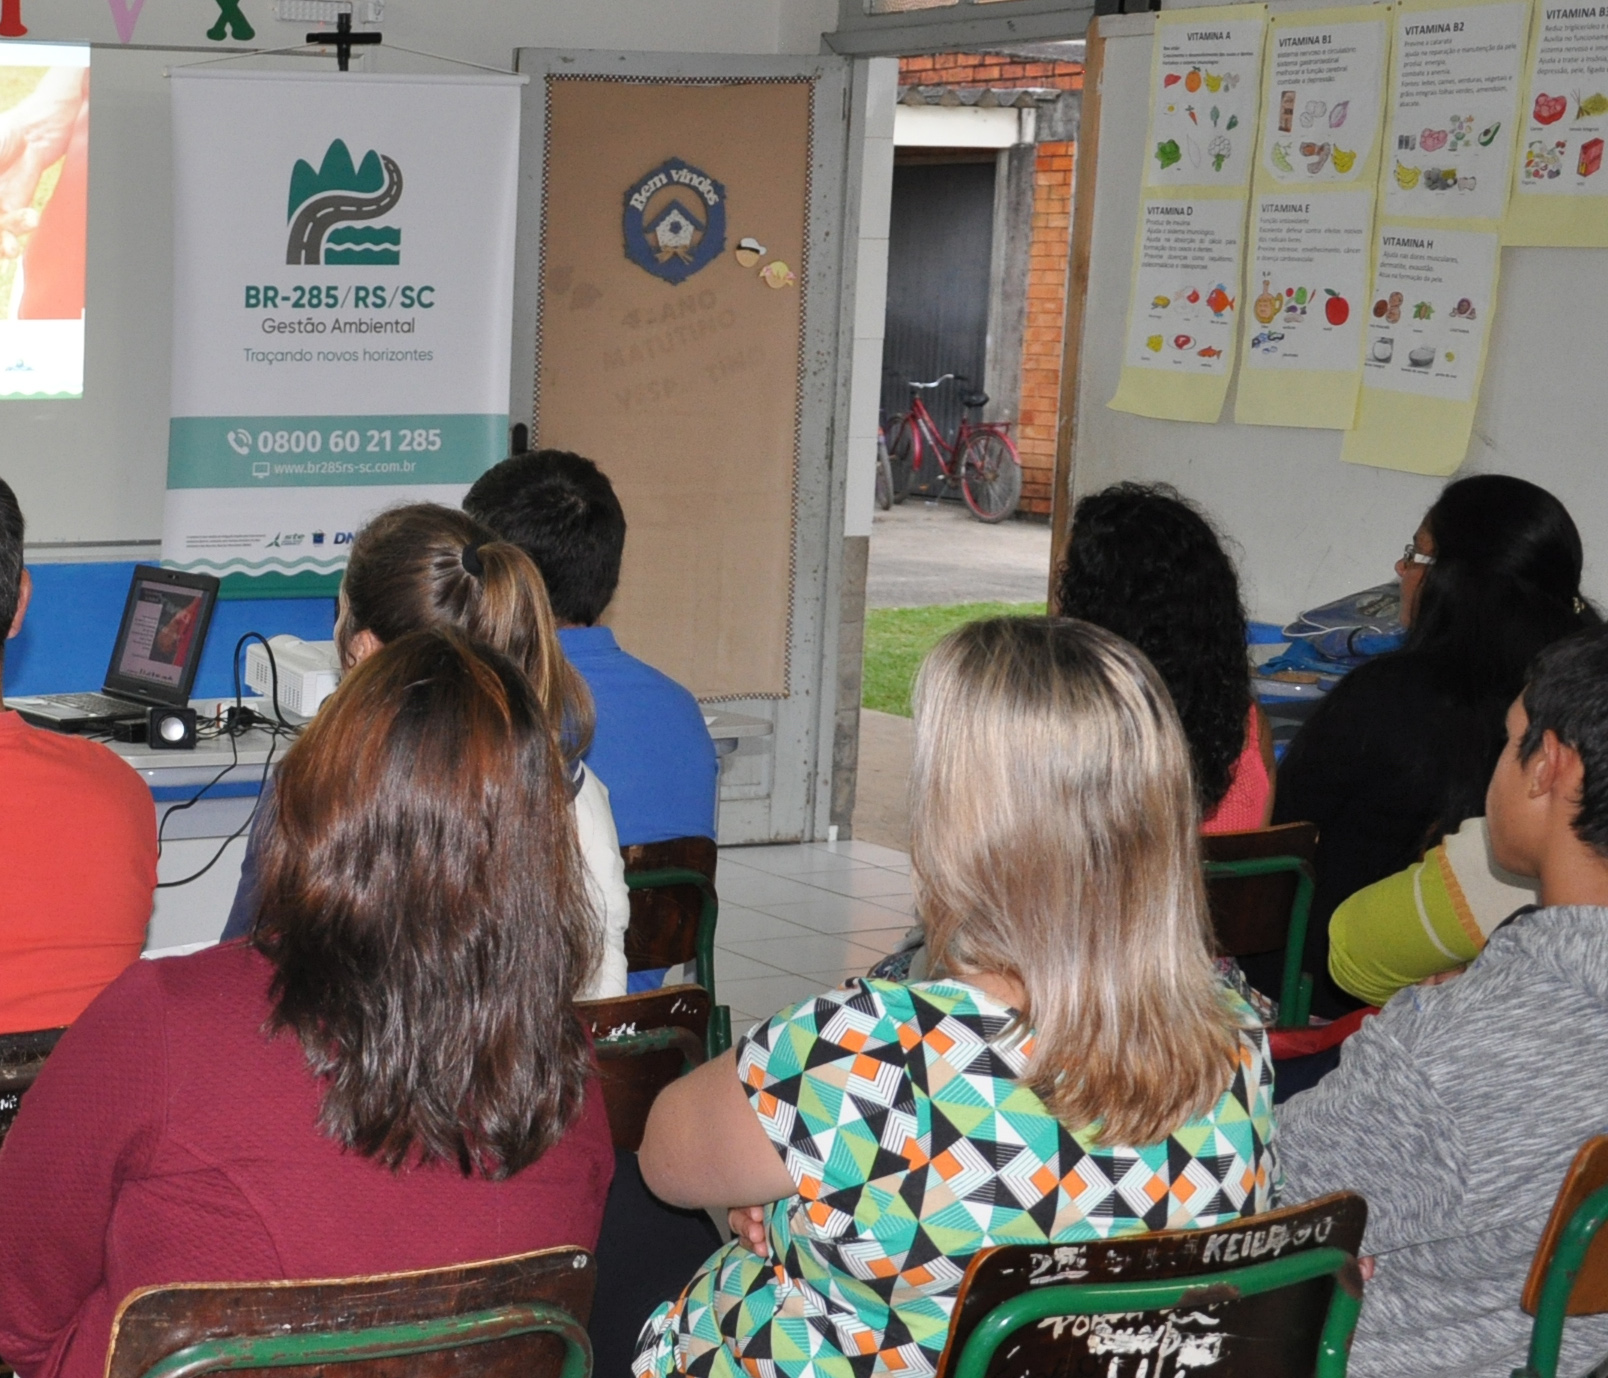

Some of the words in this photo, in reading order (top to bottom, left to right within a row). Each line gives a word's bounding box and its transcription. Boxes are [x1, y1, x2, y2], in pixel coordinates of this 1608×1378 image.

[1546, 7, 1597, 20] VITAMINA
[1404, 23, 1451, 36] VITAMINA
[1453, 21, 1465, 32] B2
[1186, 31, 1224, 41] VITAMINA
[1225, 31, 1231, 40] A
[1278, 36, 1320, 48] VITAMINA
[1321, 34, 1332, 44] B1
[1146, 206, 1185, 215] VITAMINA
[1186, 206, 1194, 216] D
[1261, 204, 1303, 213] VITAMINA
[1304, 204, 1311, 213] E
[1382, 236, 1425, 249] VITAMINA
[1426, 240, 1434, 249] H
[244, 285, 436, 309] BR-285/RS/SC
[261, 316, 327, 334] Gestão
[330, 317, 416, 334] Ambiental
[244, 348, 313, 365] Traçando
[316, 351, 359, 362] novos
[362, 348, 434, 362] horizontes
[257, 430, 322, 453] 0800
[328, 429, 361, 453] 60
[366, 429, 392, 452] 21
[397, 428, 442, 452] 285
[273, 460, 417, 475] www.br285rs-sc.com.br
[333, 531, 356, 545] DN
